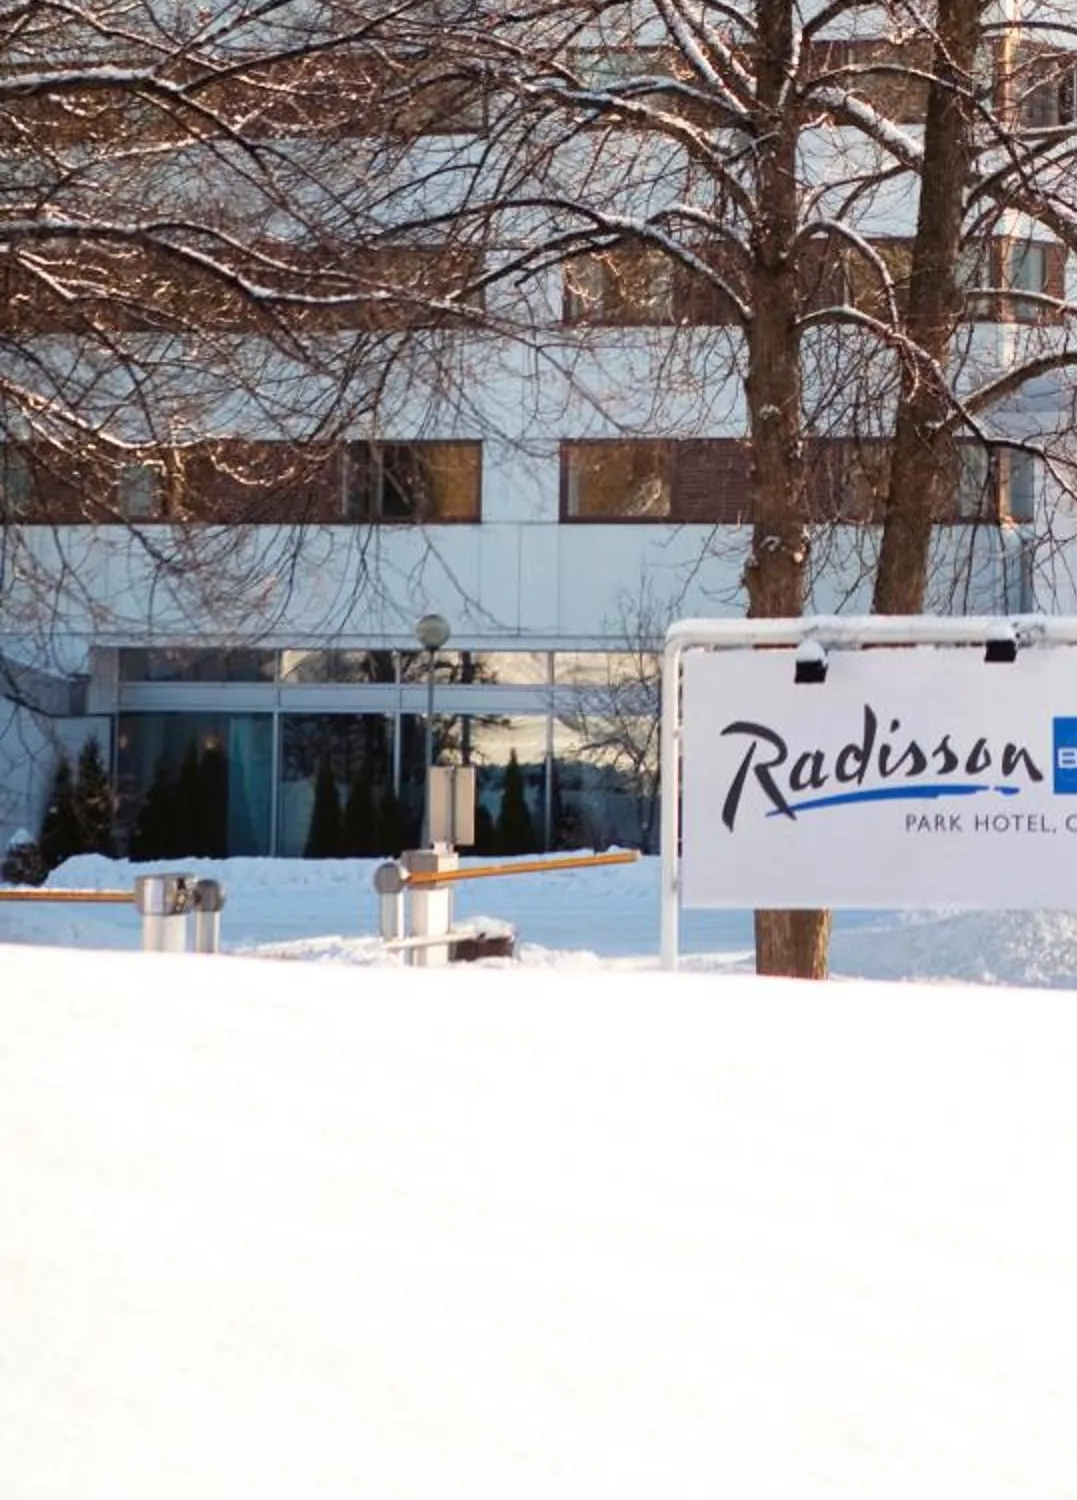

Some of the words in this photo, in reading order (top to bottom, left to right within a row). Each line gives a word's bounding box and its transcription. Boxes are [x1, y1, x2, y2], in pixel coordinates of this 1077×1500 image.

[720, 704, 1044, 833] Radisson
[905, 813, 963, 833] PARK
[974, 813, 1057, 834] HOTEL,
